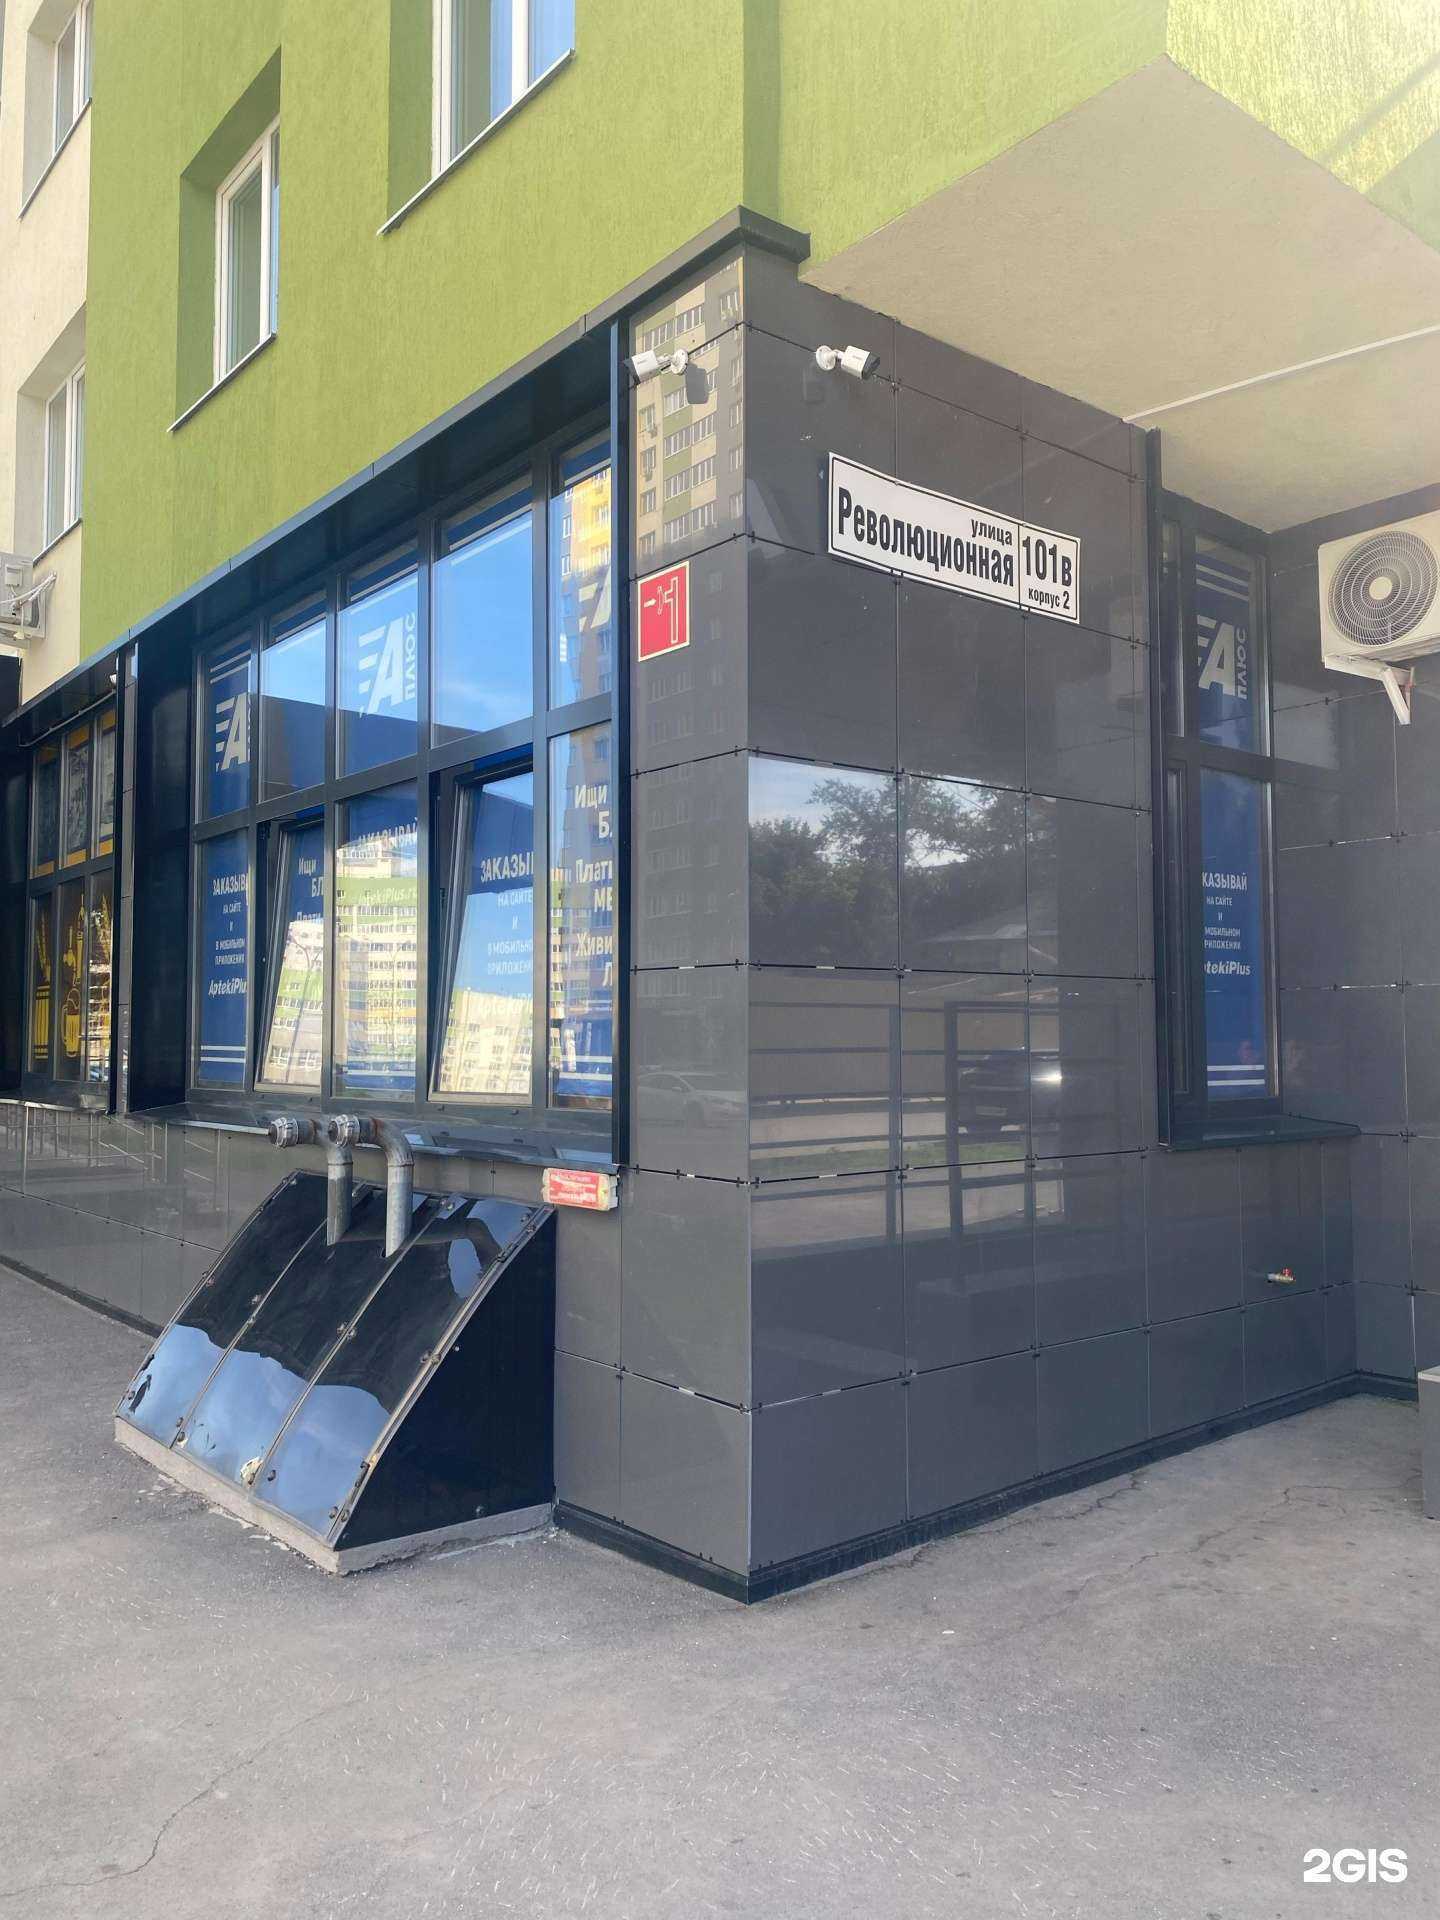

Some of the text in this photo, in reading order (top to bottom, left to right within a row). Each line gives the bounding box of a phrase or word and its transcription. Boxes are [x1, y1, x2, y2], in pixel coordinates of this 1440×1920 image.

[838, 486, 1014, 587] Революционная
[971, 519, 1012, 546] улица
[1028, 587, 1070, 610] корпус 2
[404, 611, 416, 701] ПЛЮС
[1236, 626, 1248, 700] ПЛЮС
[574, 784, 607, 809] Ищи
[598, 810, 612, 839] Б
[298, 858, 317, 876] Ищи
[213, 872, 248, 896] ЗАКАЗЫВ
[1202, 871, 1248, 891] КАЗЫВАЙ
[498, 893, 509, 907] НА
[1206, 895, 1232, 906] НА САЙТЕ
[512, 917, 519, 931] И
[1204, 960, 1251, 976] tekiPlus
[208, 977, 248, 999] AptekiPlu
